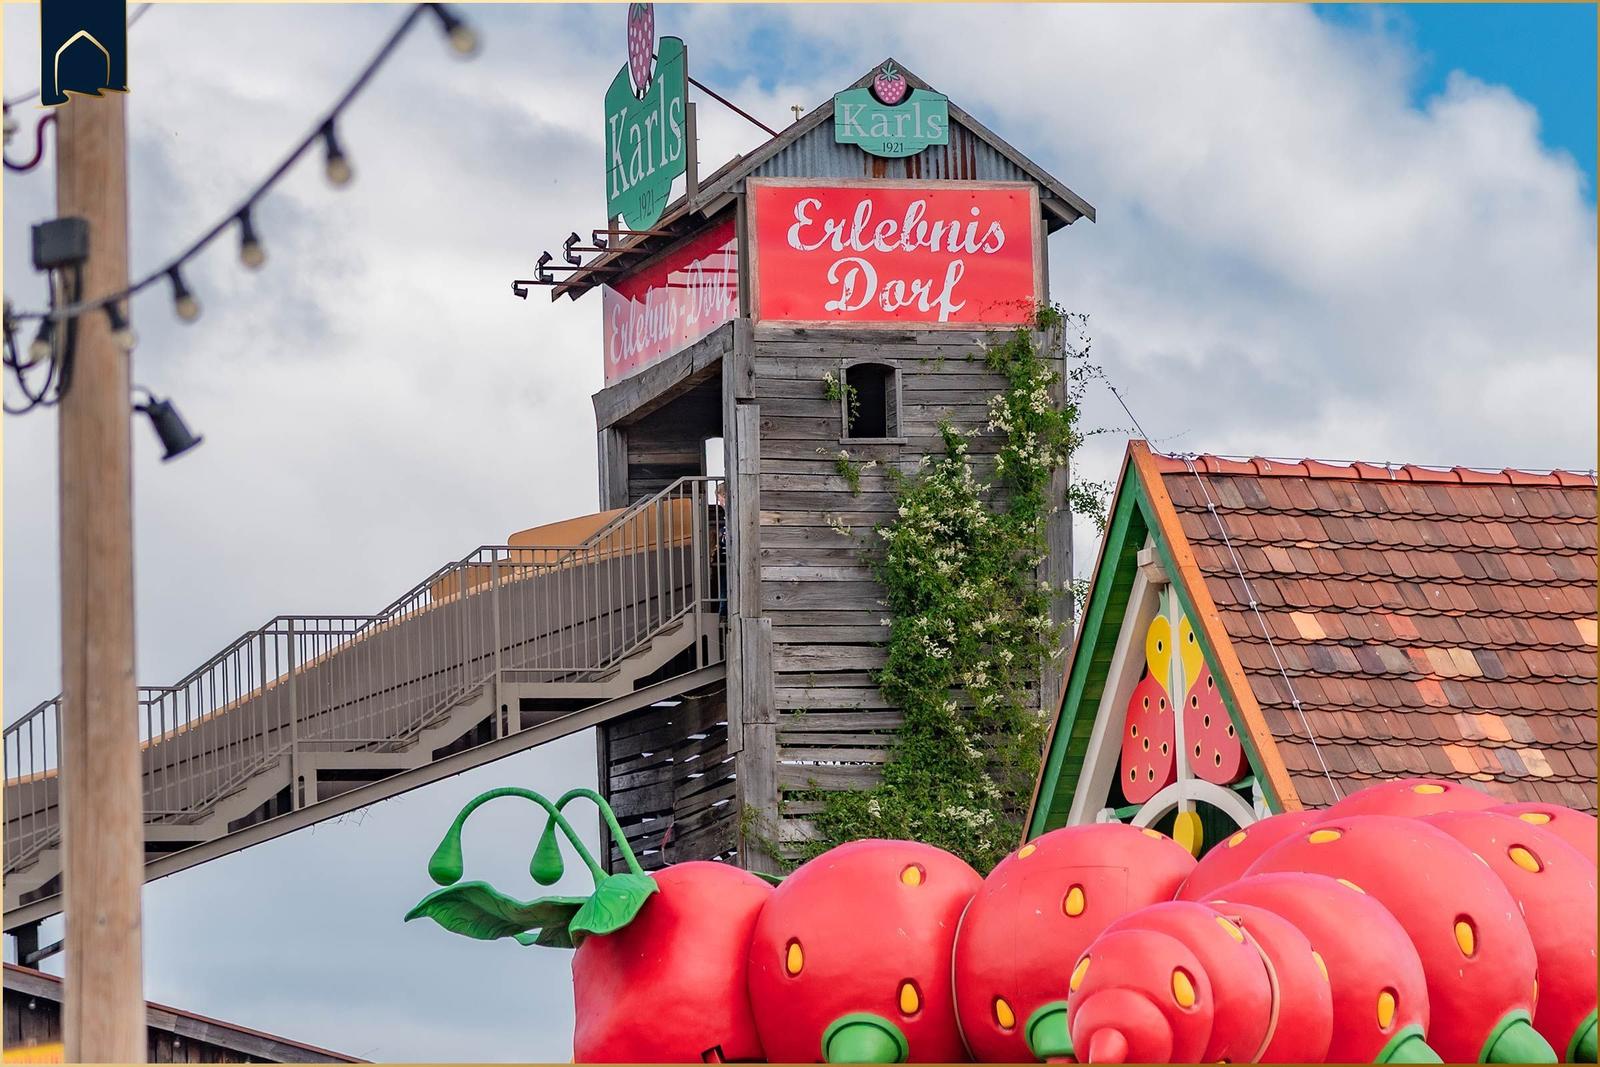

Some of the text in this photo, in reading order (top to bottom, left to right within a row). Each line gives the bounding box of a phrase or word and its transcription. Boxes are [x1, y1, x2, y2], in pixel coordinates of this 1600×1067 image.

[609, 73, 682, 200] Karls
[842, 102, 942, 139] Karls
[882, 142, 904, 153] 1921
[638, 189, 655, 221] 1921
[787, 198, 1006, 253] Erlebnis
[824, 257, 966, 322] Dorf
